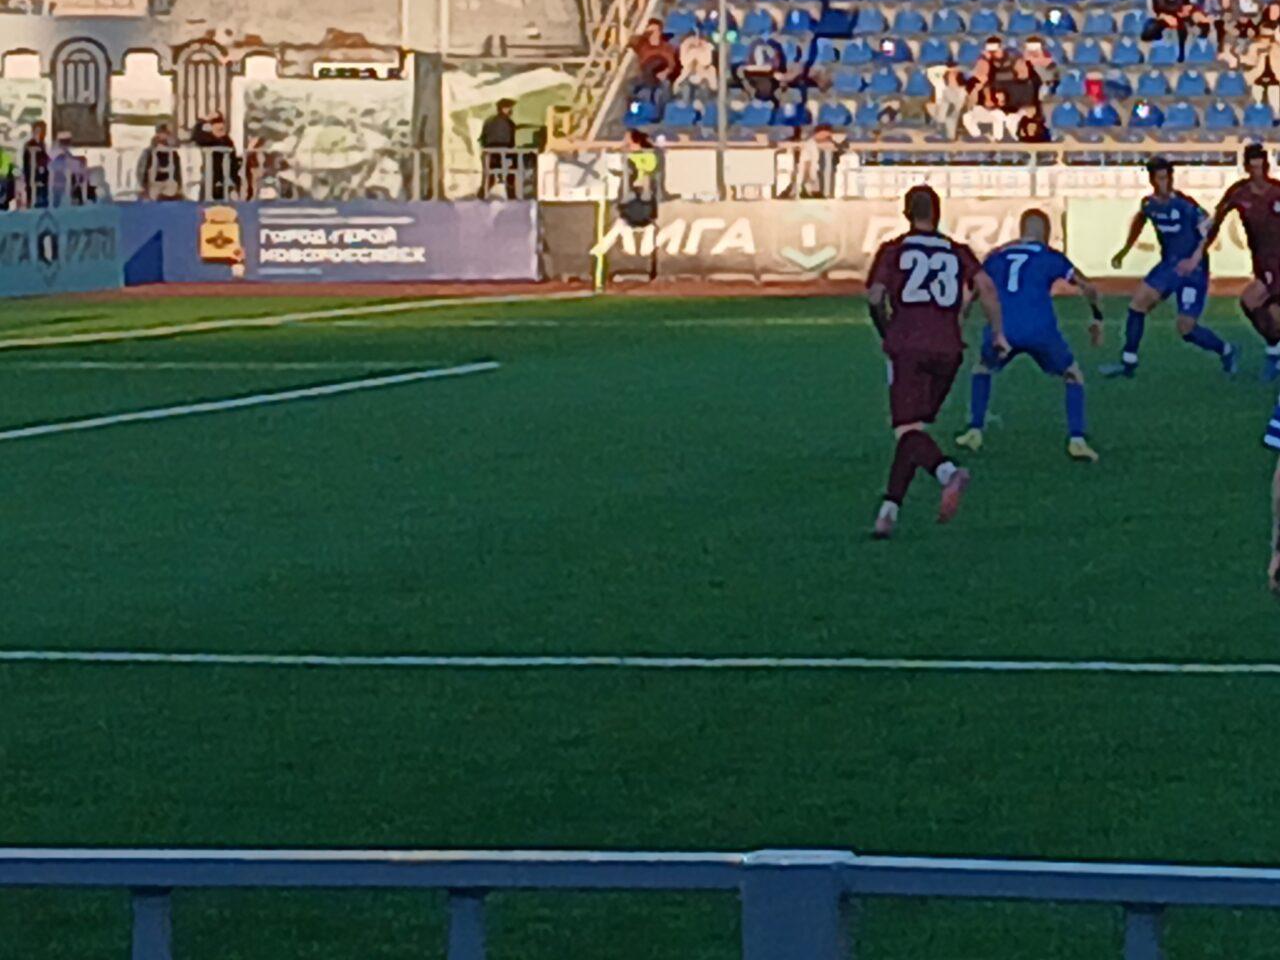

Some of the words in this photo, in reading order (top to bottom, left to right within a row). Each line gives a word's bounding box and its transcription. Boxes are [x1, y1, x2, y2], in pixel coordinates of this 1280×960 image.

[590, 217, 756, 256] ЛИГА
[900, 249, 960, 307] 23
[1006, 253, 1029, 293] 7
